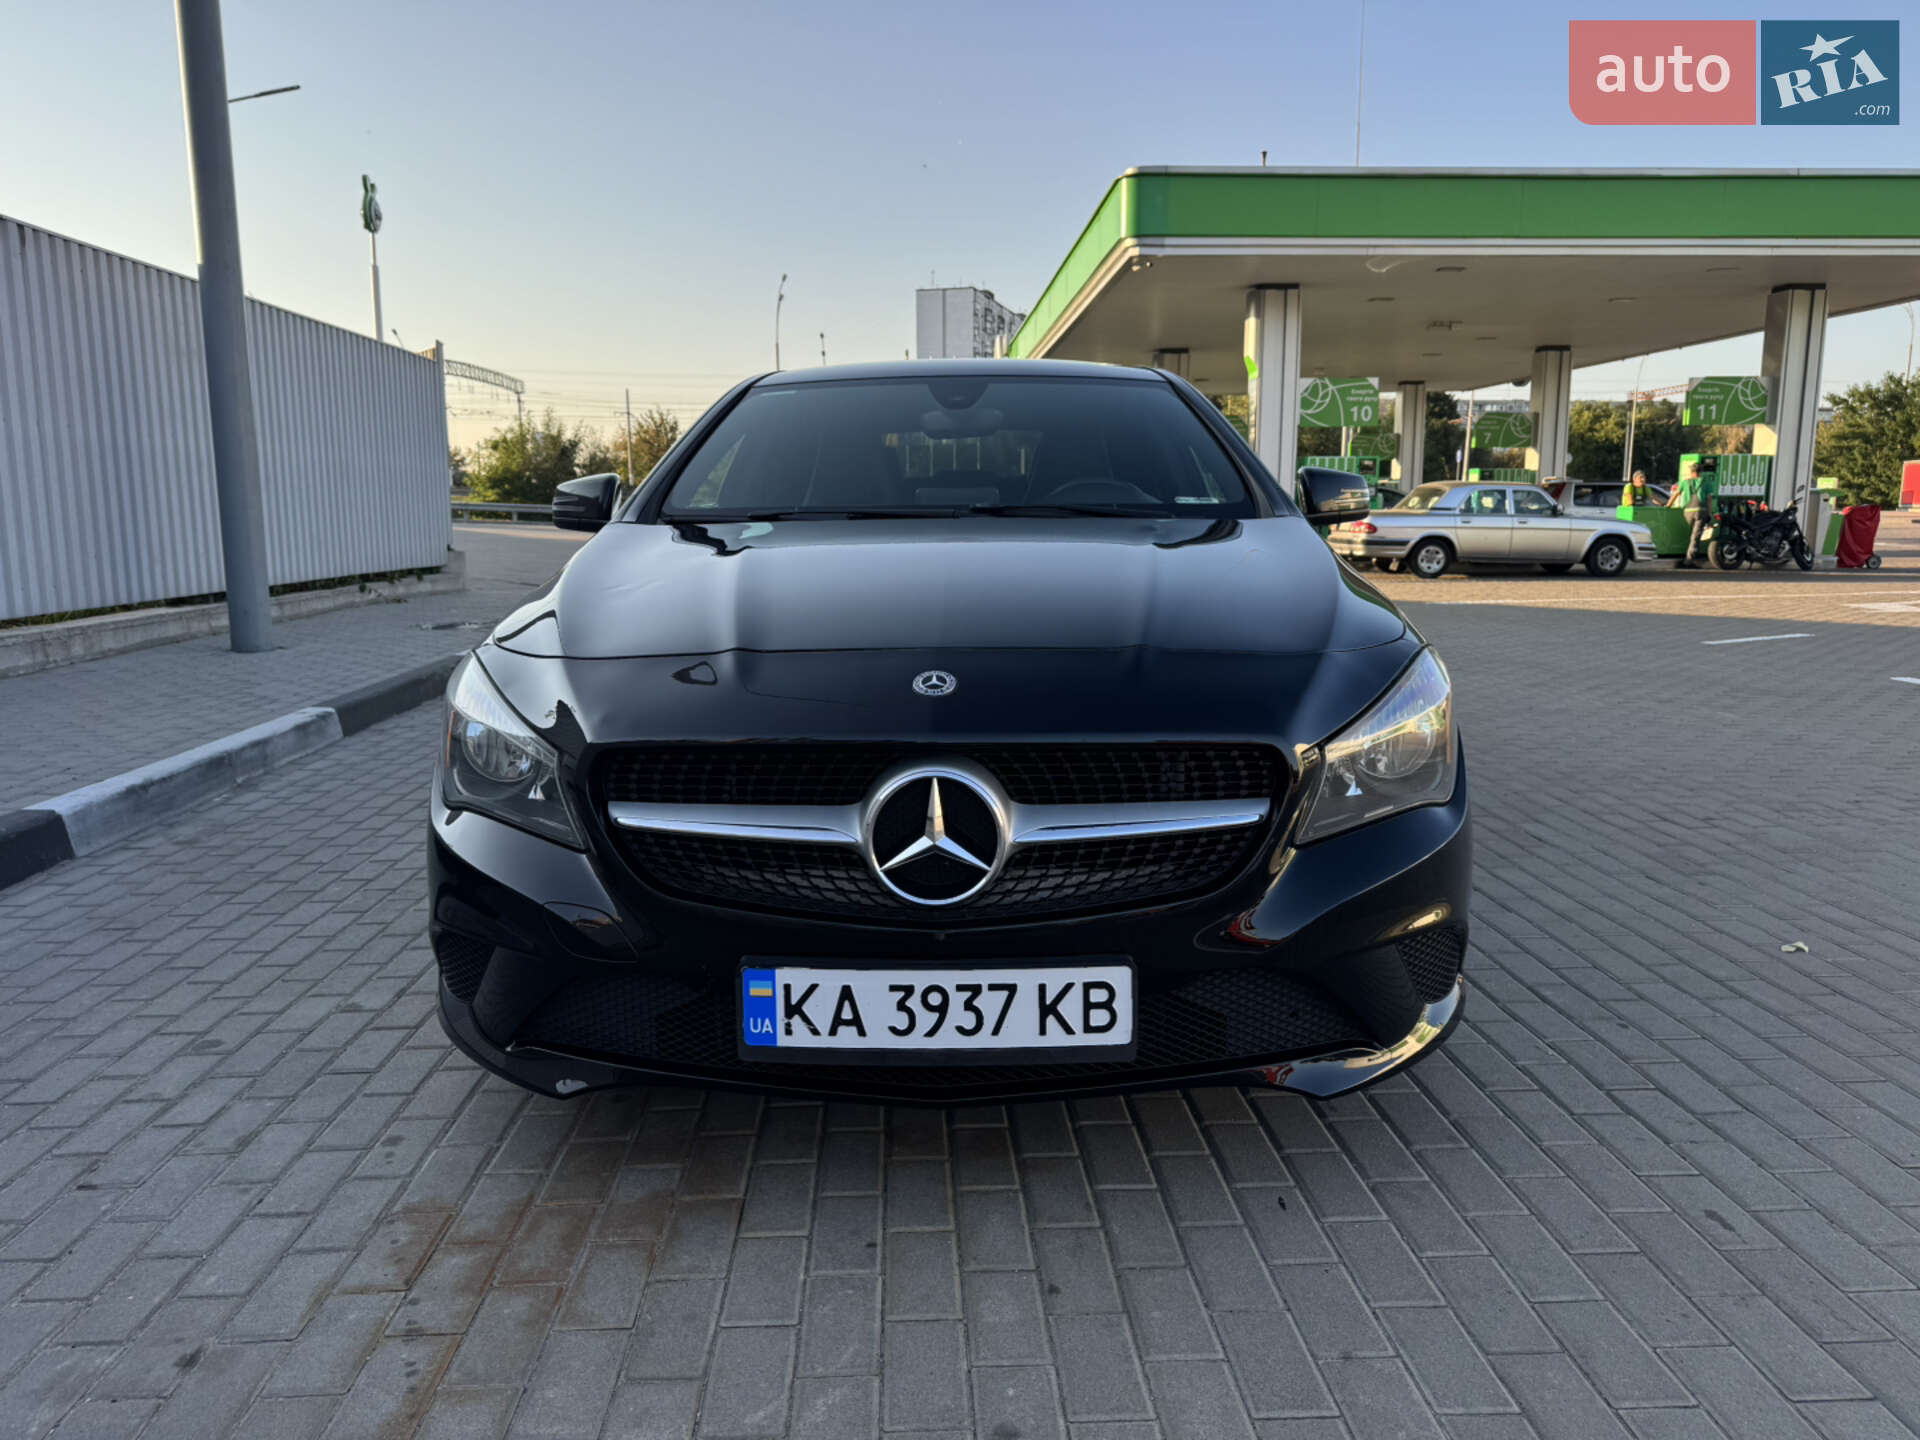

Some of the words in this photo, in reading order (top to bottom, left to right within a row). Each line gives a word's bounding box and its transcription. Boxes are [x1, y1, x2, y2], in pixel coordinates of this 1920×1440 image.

[1351, 406, 1372, 422] 10
[1698, 404, 1716, 420] 11
[782, 983, 867, 1037] KA
[887, 984, 1018, 1037] 3937
[1037, 981, 1118, 1036] KB
[749, 1017, 774, 1034] UA
